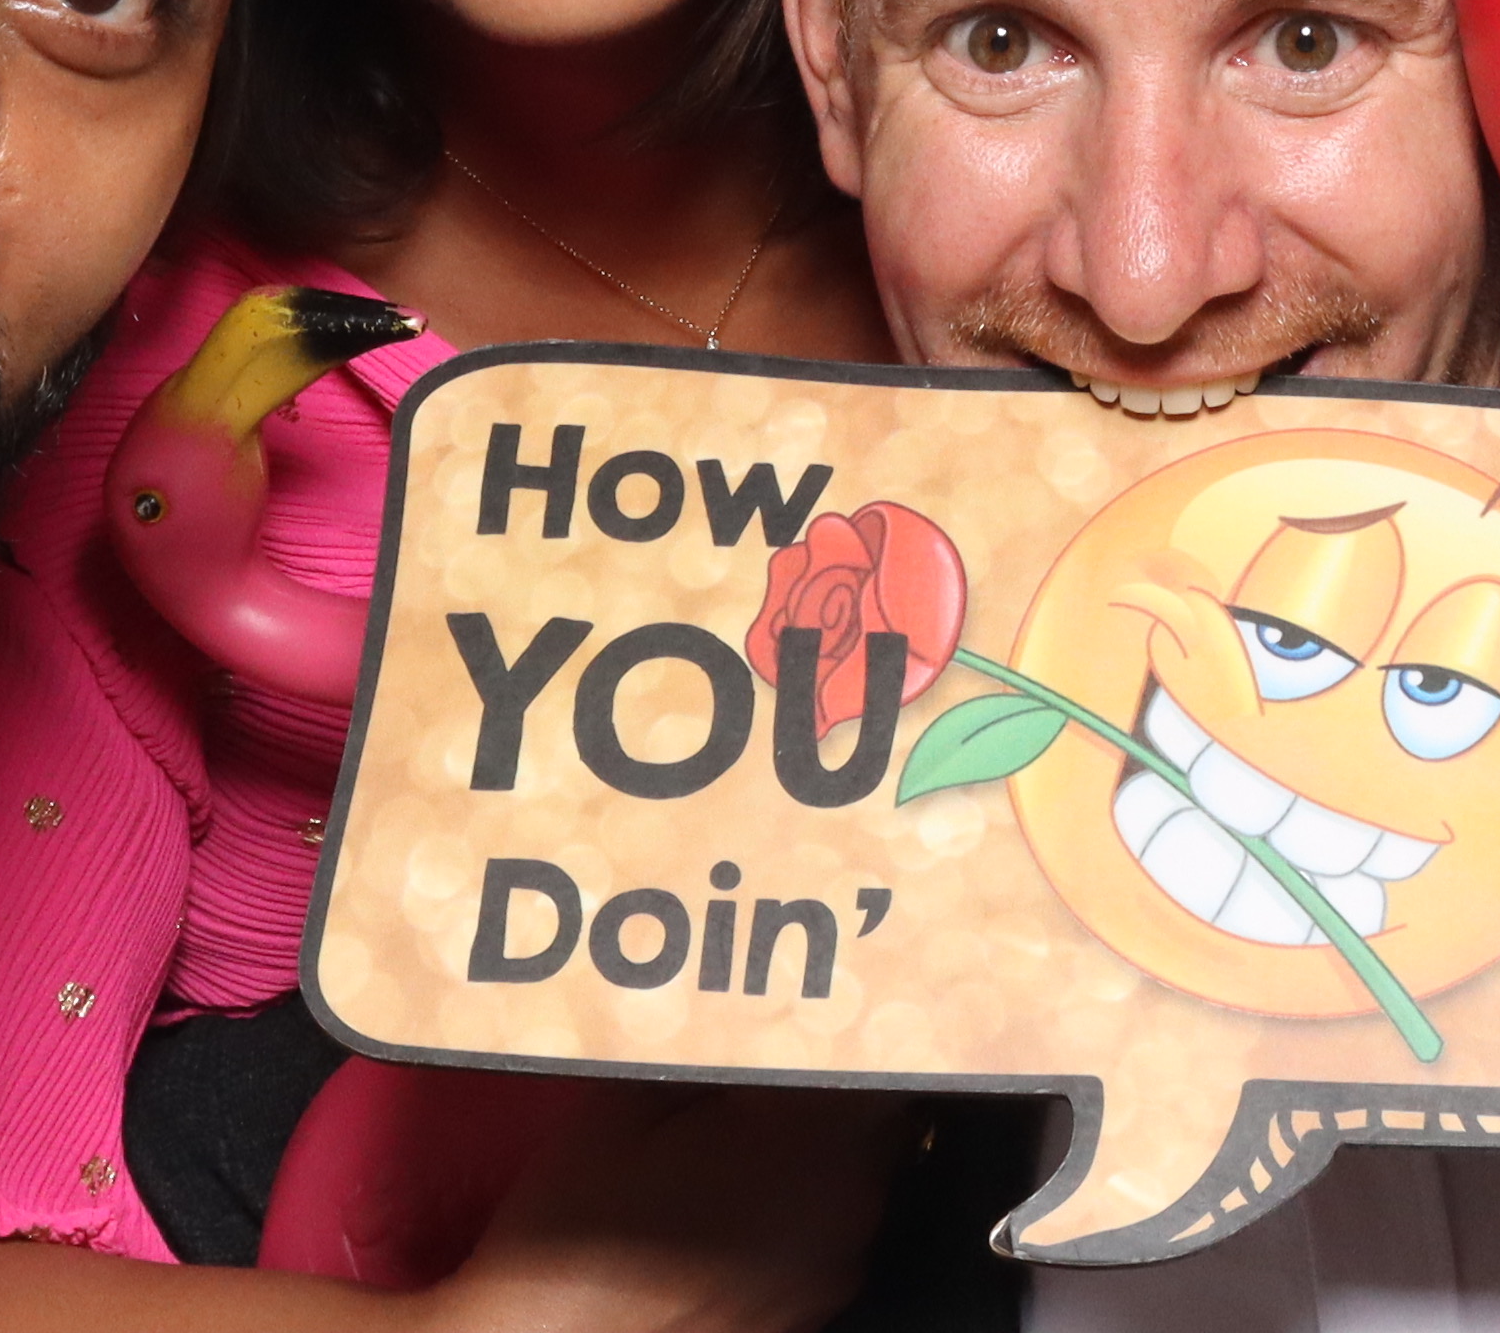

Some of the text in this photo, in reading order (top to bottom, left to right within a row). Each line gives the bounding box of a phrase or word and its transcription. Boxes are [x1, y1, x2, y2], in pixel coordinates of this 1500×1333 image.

[475, 422, 835, 548] How
[446, 611, 909, 809] YOU
[466, 856, 895, 1001] Doin'
